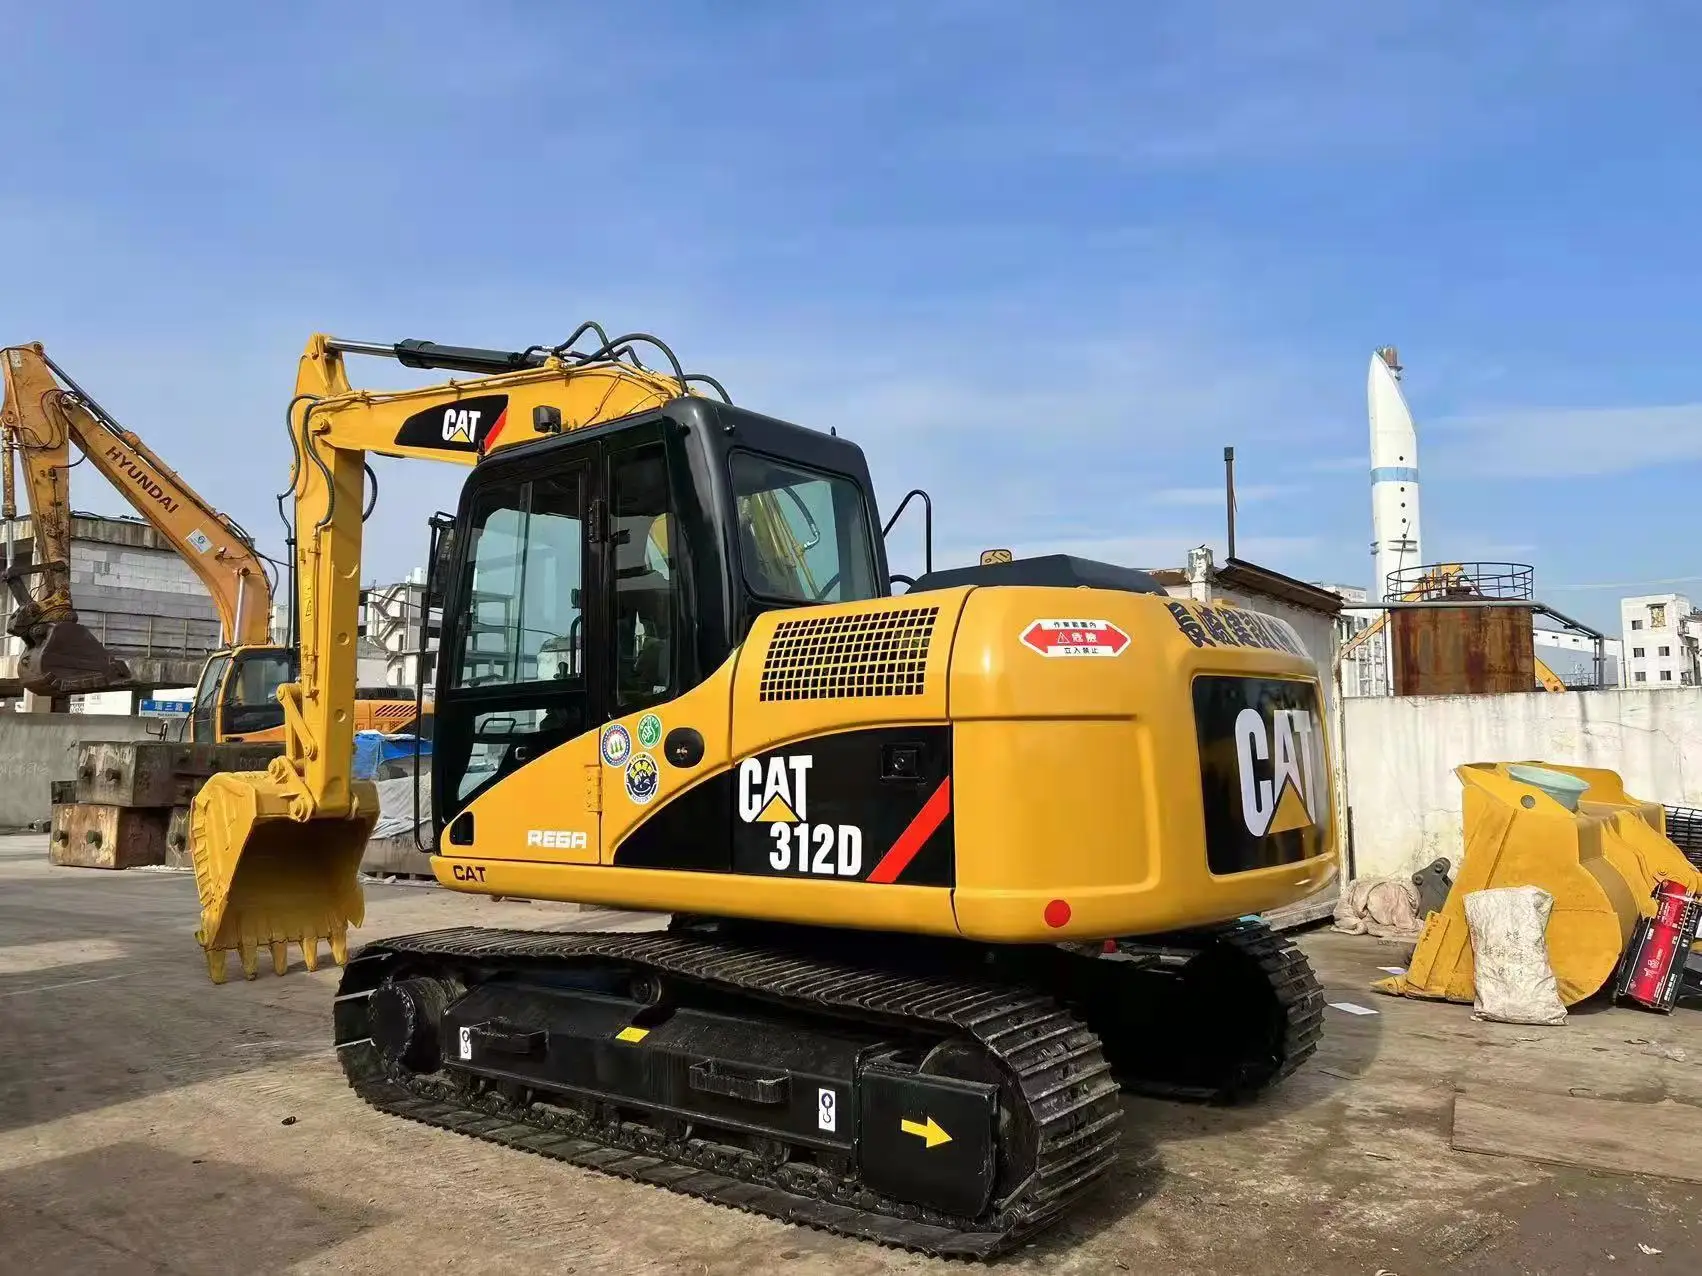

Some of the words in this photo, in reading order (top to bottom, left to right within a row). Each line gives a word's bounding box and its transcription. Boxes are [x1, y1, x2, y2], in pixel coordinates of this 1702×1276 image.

[442, 409, 482, 443] CAT
[105, 446, 180, 513] HYUNDAI
[1064, 646, 1099, 654] 立入禁止
[738, 755, 813, 823] CAT
[1235, 708, 1316, 837] CAT
[453, 865, 486, 882] CAT
[769, 822, 863, 876] 312D
